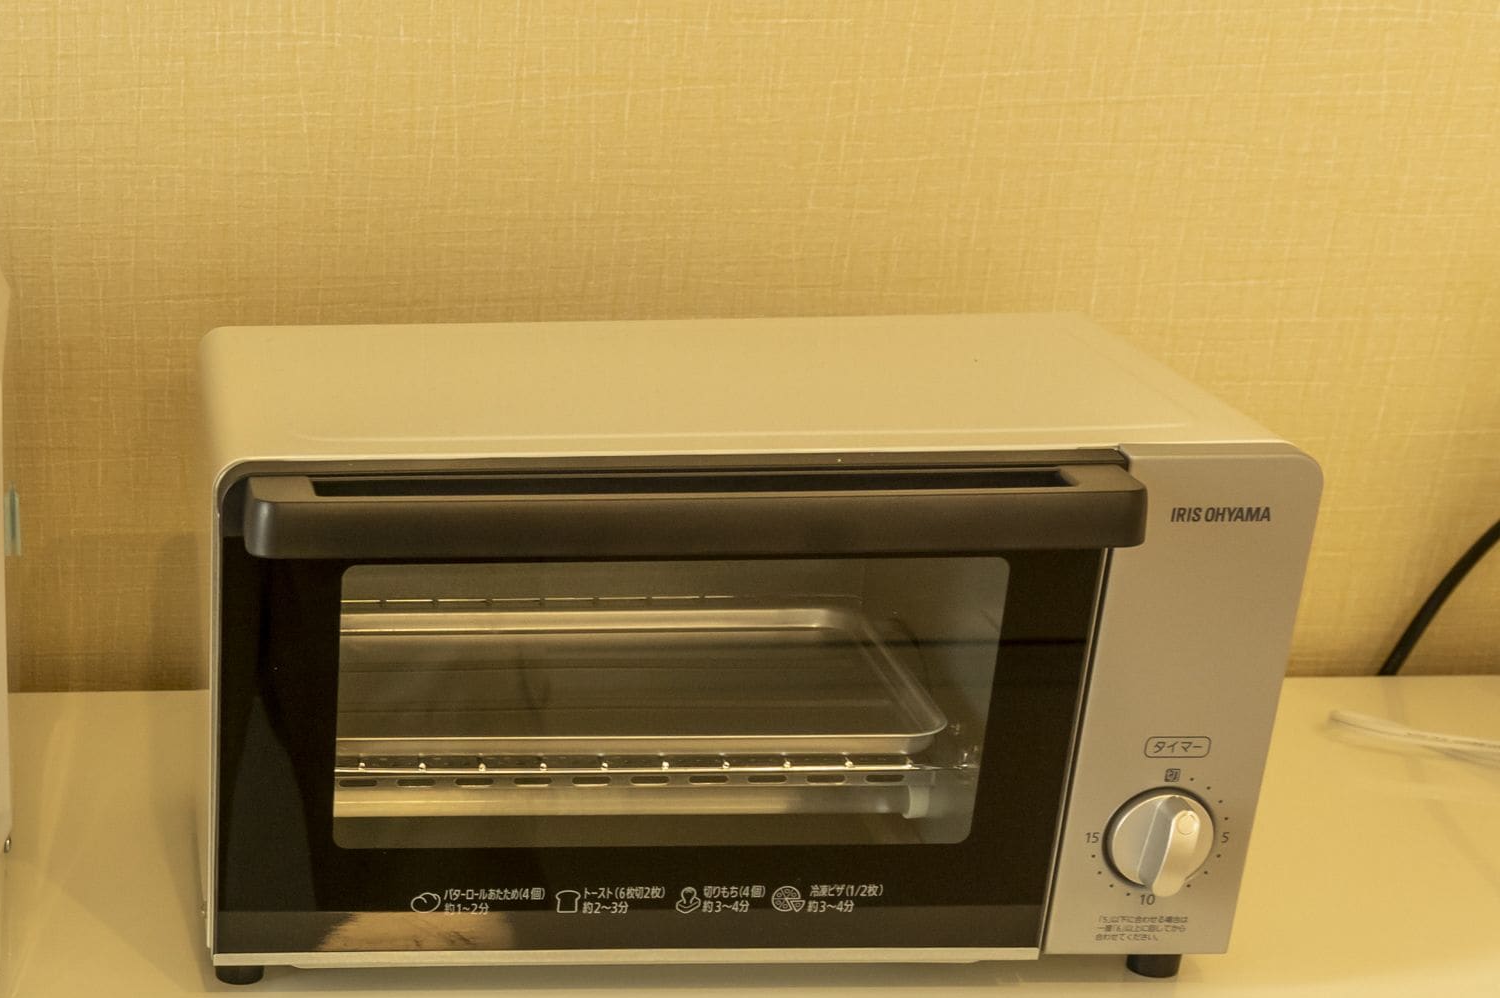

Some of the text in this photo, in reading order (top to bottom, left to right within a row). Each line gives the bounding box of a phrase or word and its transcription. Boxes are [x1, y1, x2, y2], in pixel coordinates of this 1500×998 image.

[1170, 506, 1271, 522] IRIS OHYAMA
[1153, 741, 1204, 754] タイマー
[1086, 832, 1100, 843] 15
[1221, 832, 1230, 843] 5
[1140, 894, 1155, 905] 10
